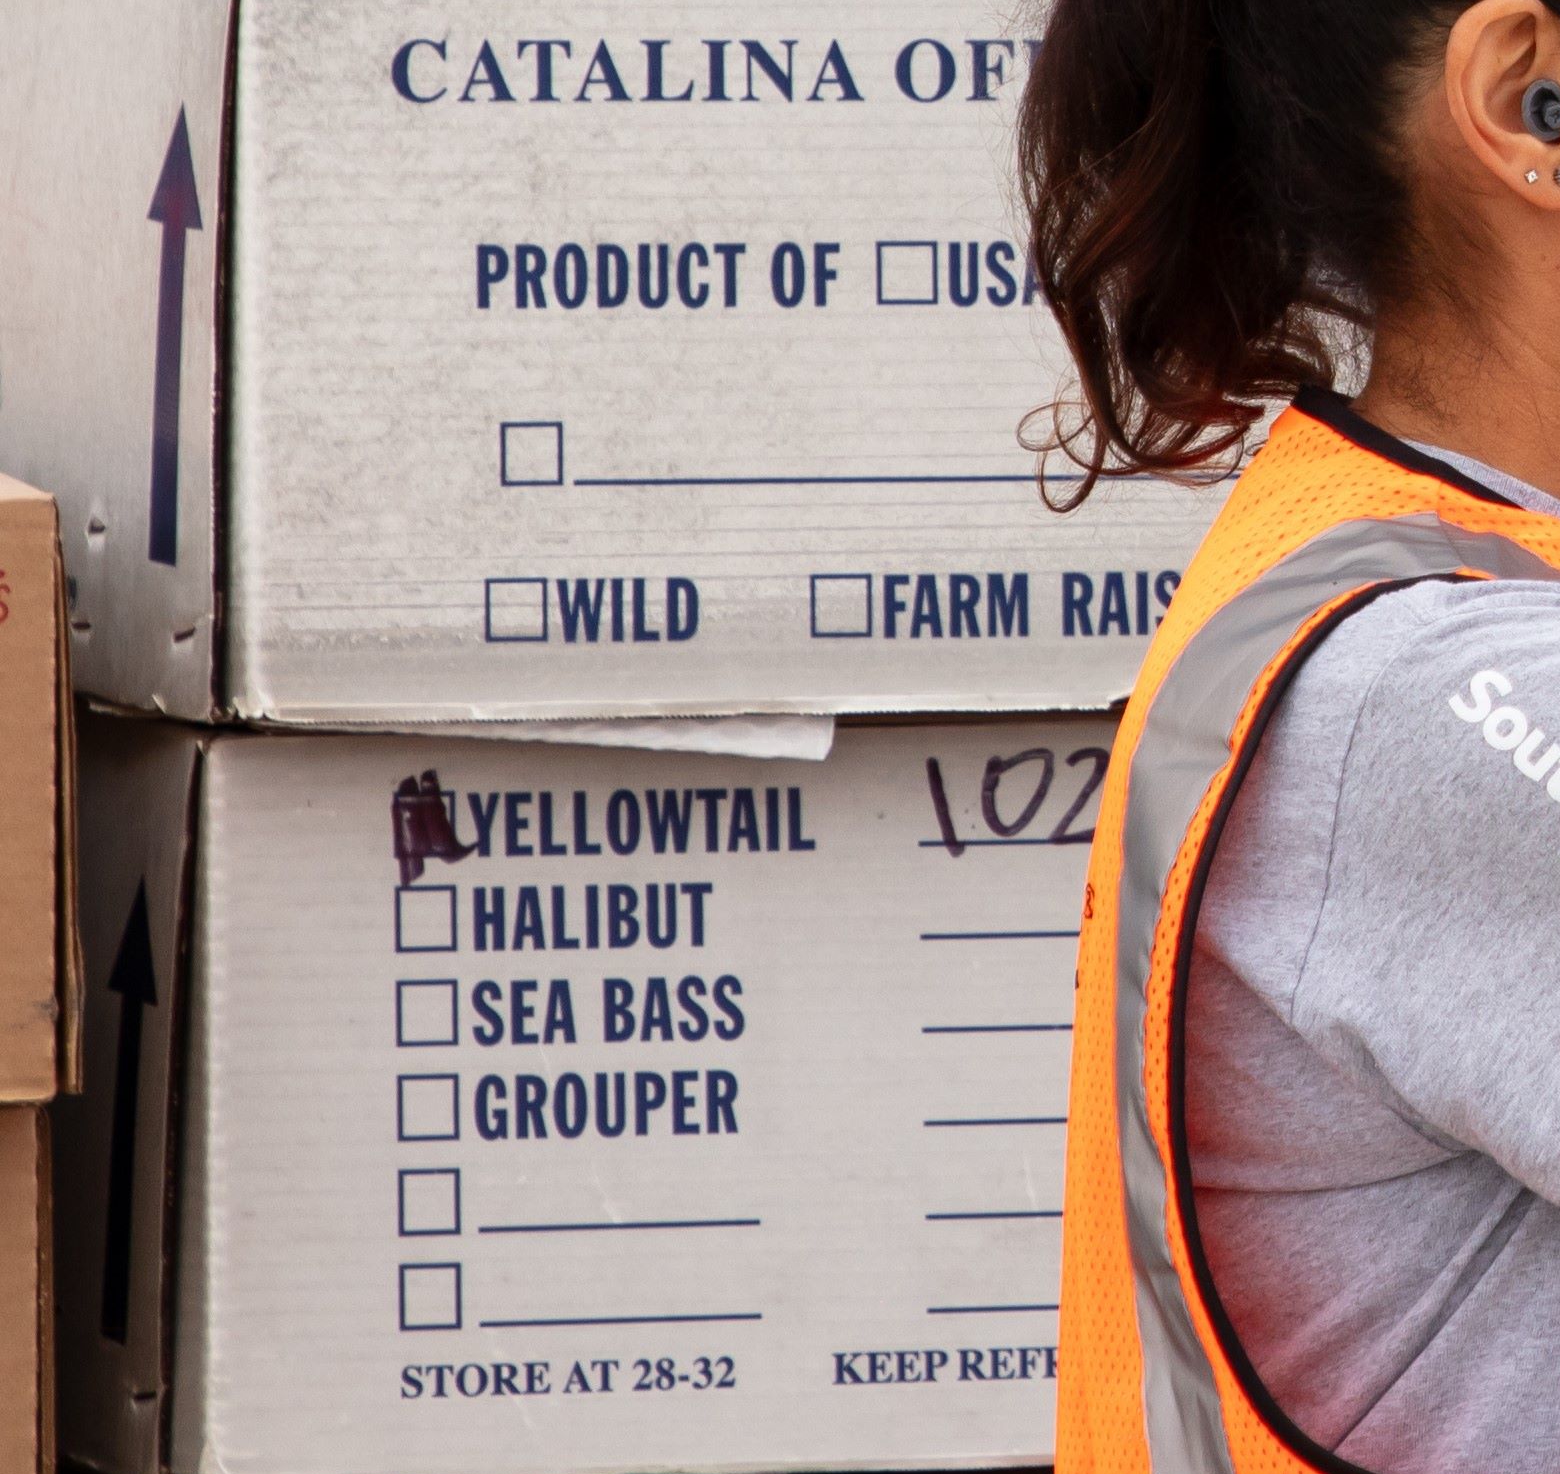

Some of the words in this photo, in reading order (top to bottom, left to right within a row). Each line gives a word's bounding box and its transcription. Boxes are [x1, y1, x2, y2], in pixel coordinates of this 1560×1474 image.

[391, 38, 865, 104] CATALINA
[477, 241, 747, 310] PRODUCT
[771, 241, 841, 308] OF
[556, 577, 700, 644] WILD
[883, 572, 1029, 639] FARM
[1058, 567, 1182, 639] RAIS
[465, 785, 818, 859] YELLOWTAIL
[473, 882, 713, 952] HALIBUT
[472, 978, 577, 1047] SEA
[603, 974, 745, 1043] BASS
[474, 1069, 739, 1141] GROUPER
[401, 1362, 551, 1398] STORE
[563, 1360, 619, 1393] AT
[633, 1355, 736, 1391] 28-32
[833, 1350, 949, 1385] KEEP
